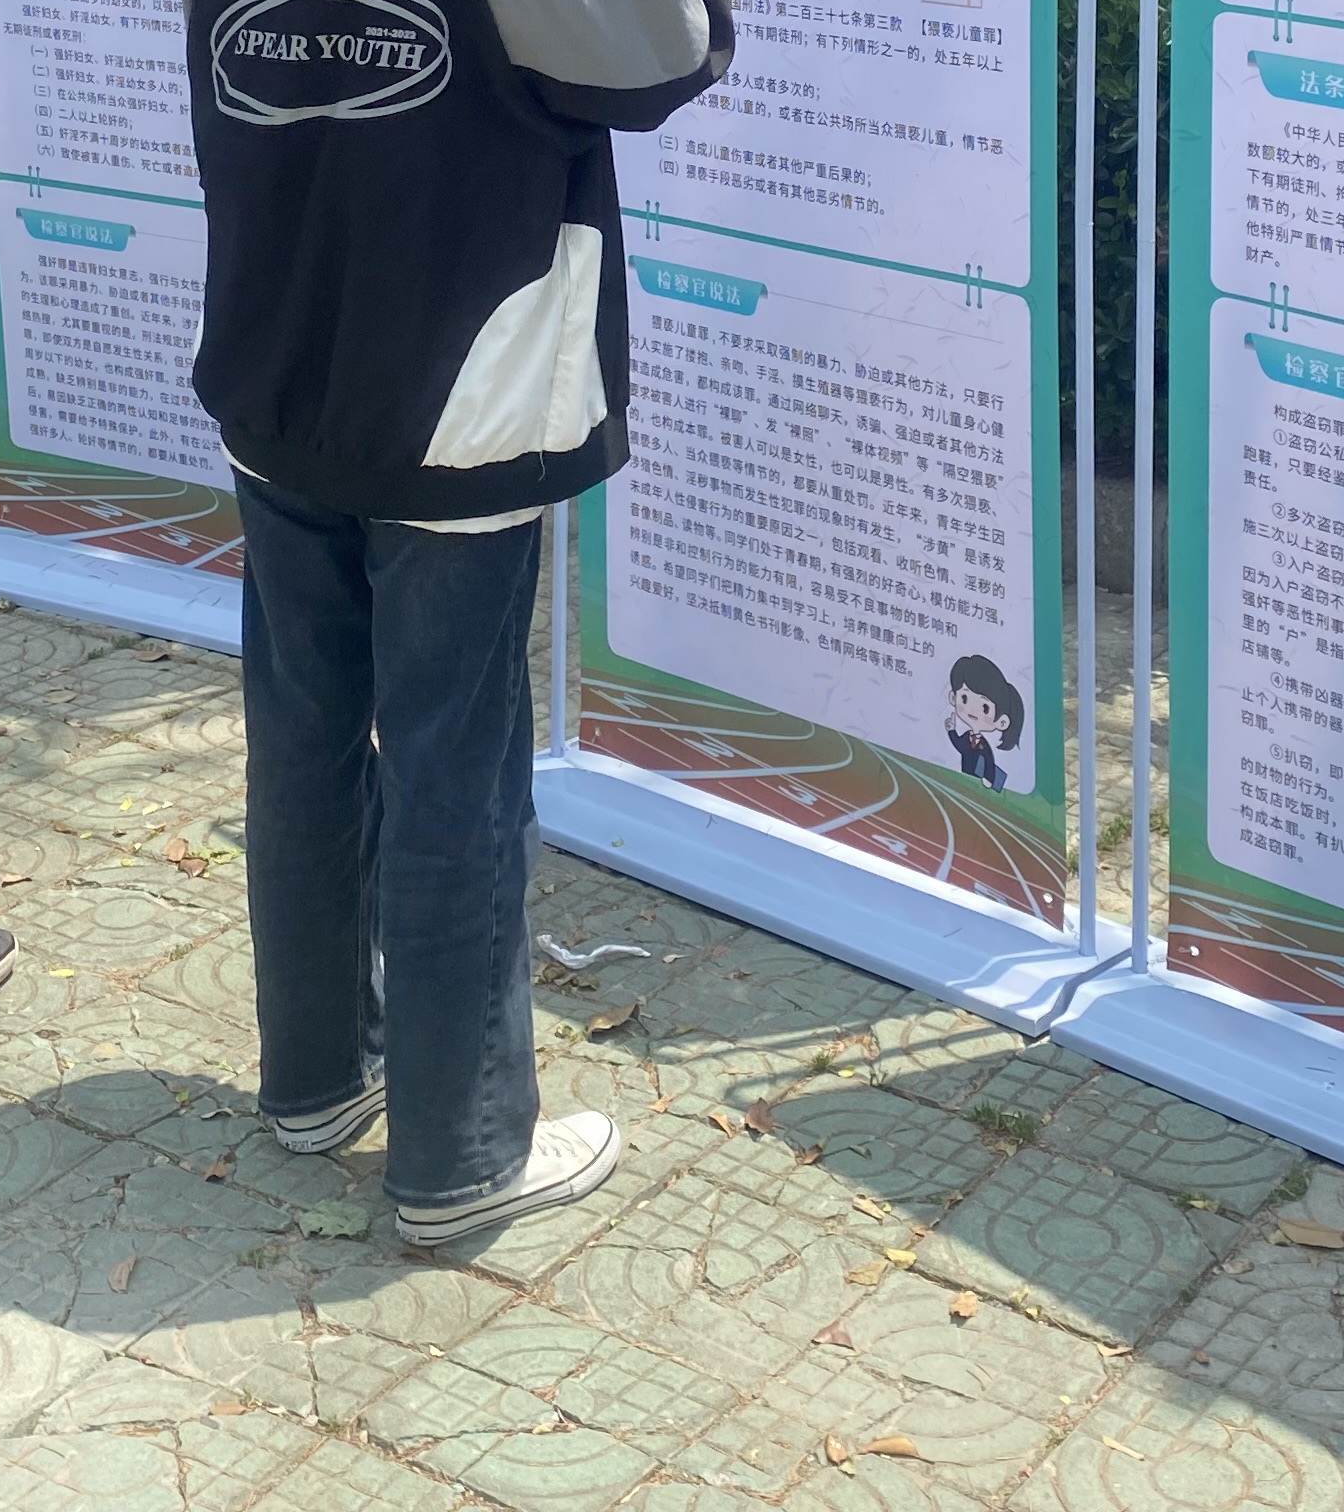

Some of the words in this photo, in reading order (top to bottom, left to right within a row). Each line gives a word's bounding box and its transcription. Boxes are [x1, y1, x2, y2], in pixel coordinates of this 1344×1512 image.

[234, 29, 310, 61] SPEAR
[315, 34, 427, 72] YOUTH
[689, 92, 1004, 155] 众猥亵儿童的，或者在公共场所当众猥亵儿童，情节恶
[1245, 245, 1281, 269] 财产。
[657, 268, 741, 306] 检察官说法
[1243, 469, 1278, 493] 责任。
